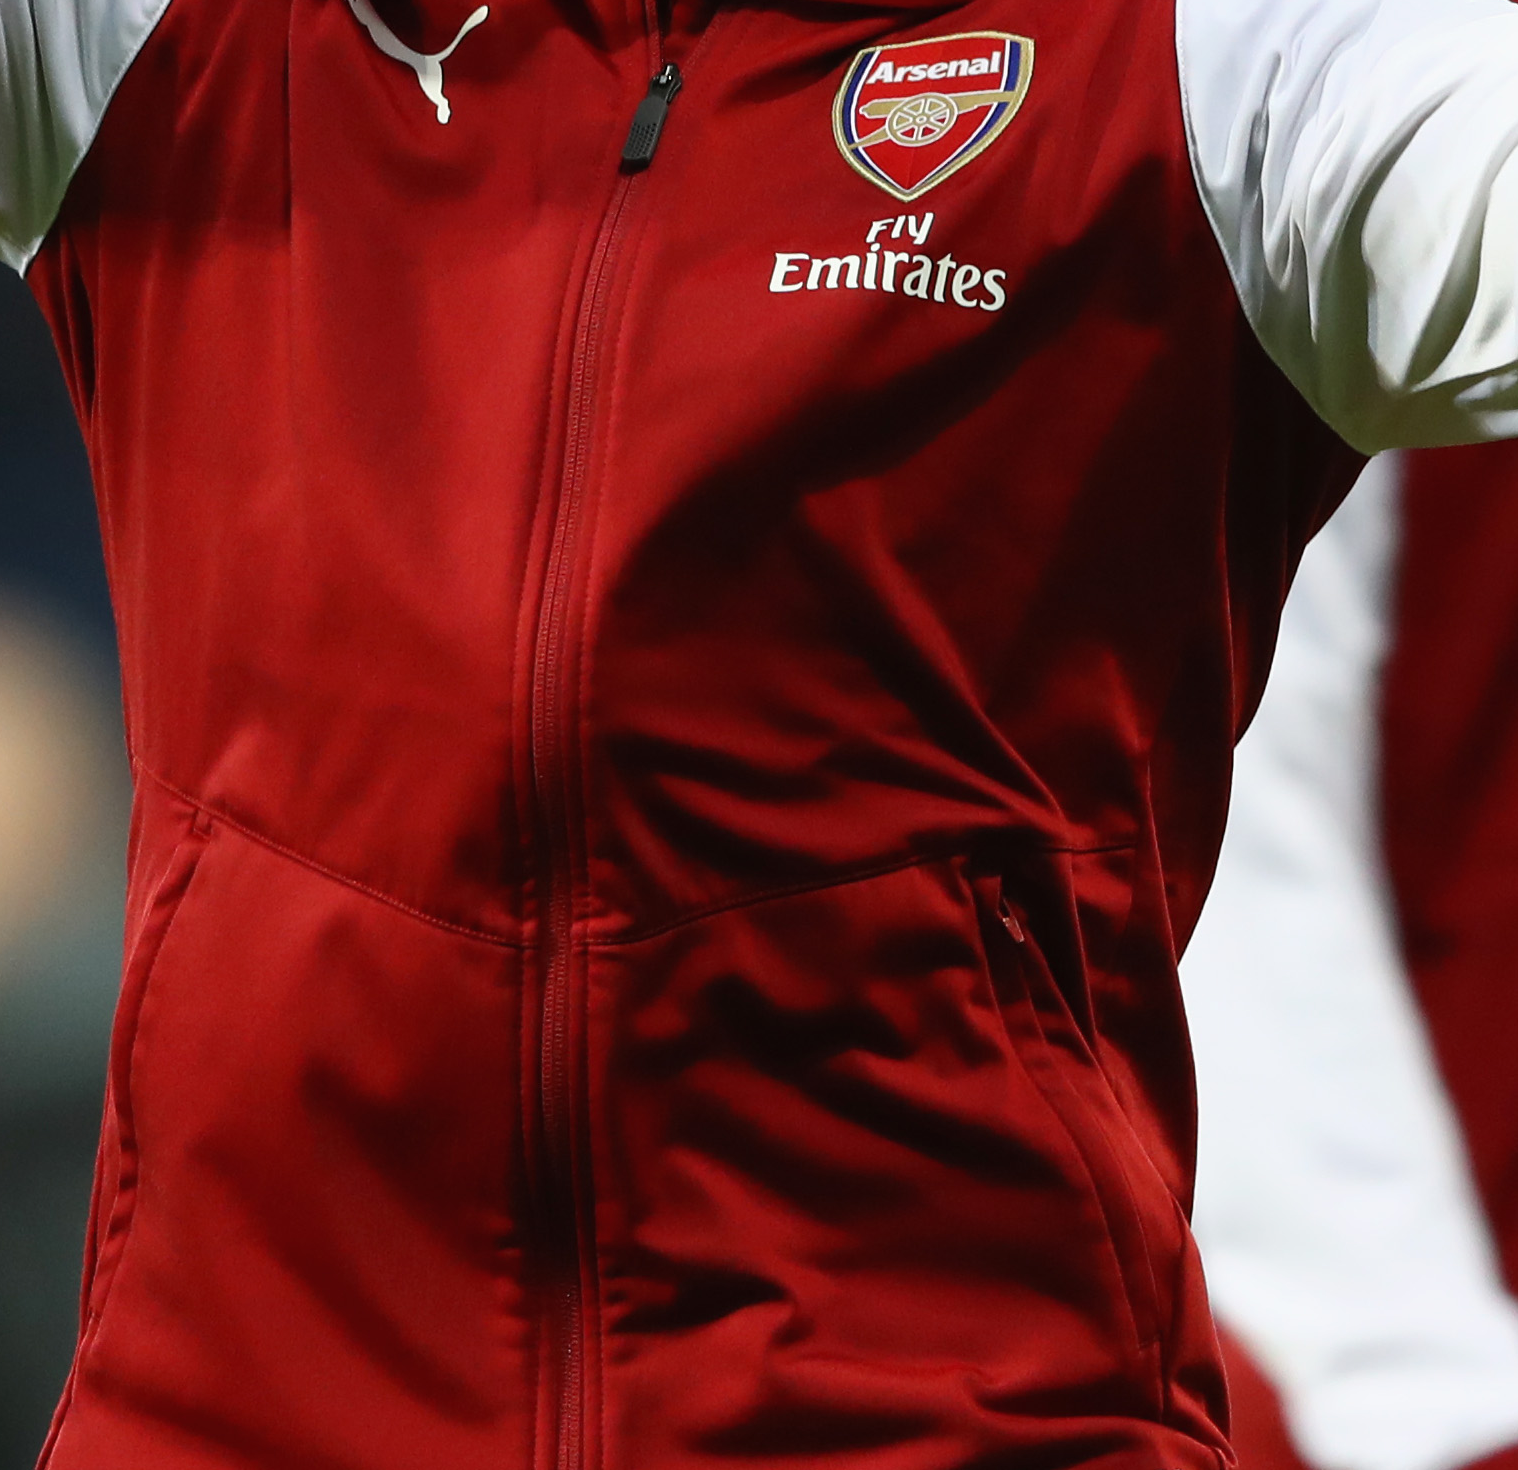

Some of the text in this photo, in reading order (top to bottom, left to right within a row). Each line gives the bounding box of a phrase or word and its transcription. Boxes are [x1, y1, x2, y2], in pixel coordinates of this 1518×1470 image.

[866, 51, 1001, 84] Arsenal
[865, 212, 934, 245] Fly
[768, 242, 1007, 311] Emirates
